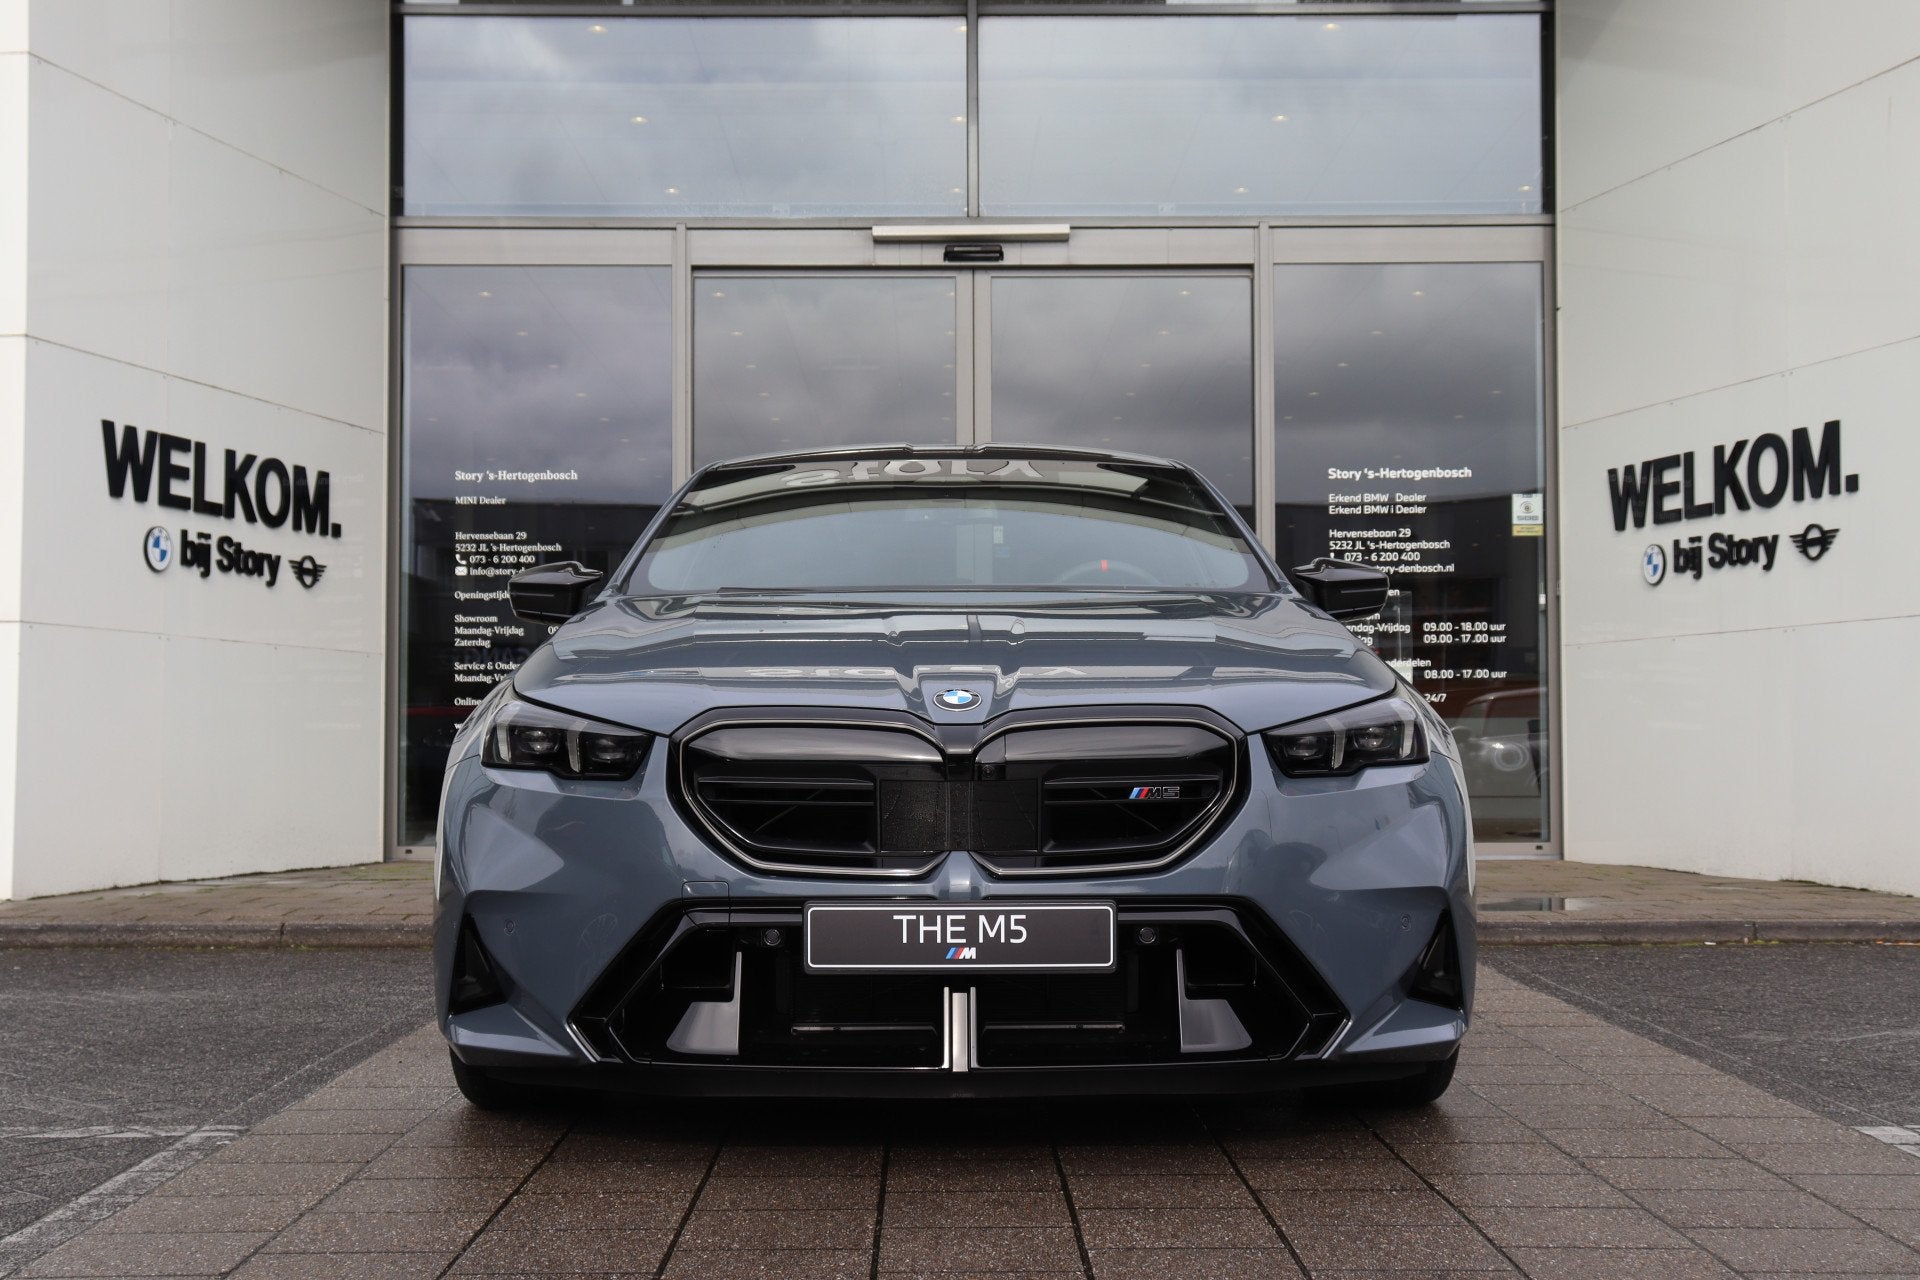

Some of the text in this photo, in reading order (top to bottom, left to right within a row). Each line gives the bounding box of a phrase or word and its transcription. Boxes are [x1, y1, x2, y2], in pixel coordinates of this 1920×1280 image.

[101, 419, 342, 539] WELKOM.
[454, 470, 483, 482] Story
[1328, 468, 1362, 481] Story
[1607, 419, 1860, 532] WELKOM.
[455, 496, 506, 504] MINI Dealer
[1328, 493, 1426, 503] Erkend BMW Dealer
[1329, 505, 1361, 515] Erkend
[1364, 505, 1389, 514] BMW
[1396, 505, 1427, 514] Dealer
[455, 532, 527, 540] Hervensebaan 29
[1329, 528, 1411, 538] Hervensebaan 29
[455, 543, 477, 552] 5232
[478, 543, 489, 552] JL
[1329, 541, 1353, 550] 5232
[1354, 541, 1365, 550] JL
[1708, 532, 1779, 571] Story
[216, 535, 281, 587] Story
[469, 555, 486, 564] 073
[494, 555, 499, 564] 6
[501, 555, 517, 564] 200
[518, 555, 535, 564] 400
[1344, 553, 1363, 562] 073
[1371, 552, 1378, 562] 6
[1380, 552, 1399, 562] 200
[1401, 552, 1420, 561] 400
[454, 615, 498, 623] Showroom
[454, 626, 524, 636] Maandag-Vrijdag
[1423, 622, 1452, 631] 09.00
[1461, 622, 1488, 631] 18.00
[1490, 623, 1506, 631] uur
[454, 638, 491, 648] Zaterdag
[1423, 634, 1453, 643] 09.00
[1491, 635, 1506, 643] uur
[454, 662, 486, 670] Service
[487, 662, 493, 670] &
[1424, 669, 1453, 679] 08.00
[1424, 694, 1446, 703] 24/7
[1146, 786, 1180, 799] M5
[893, 914, 1028, 944] THE M5
